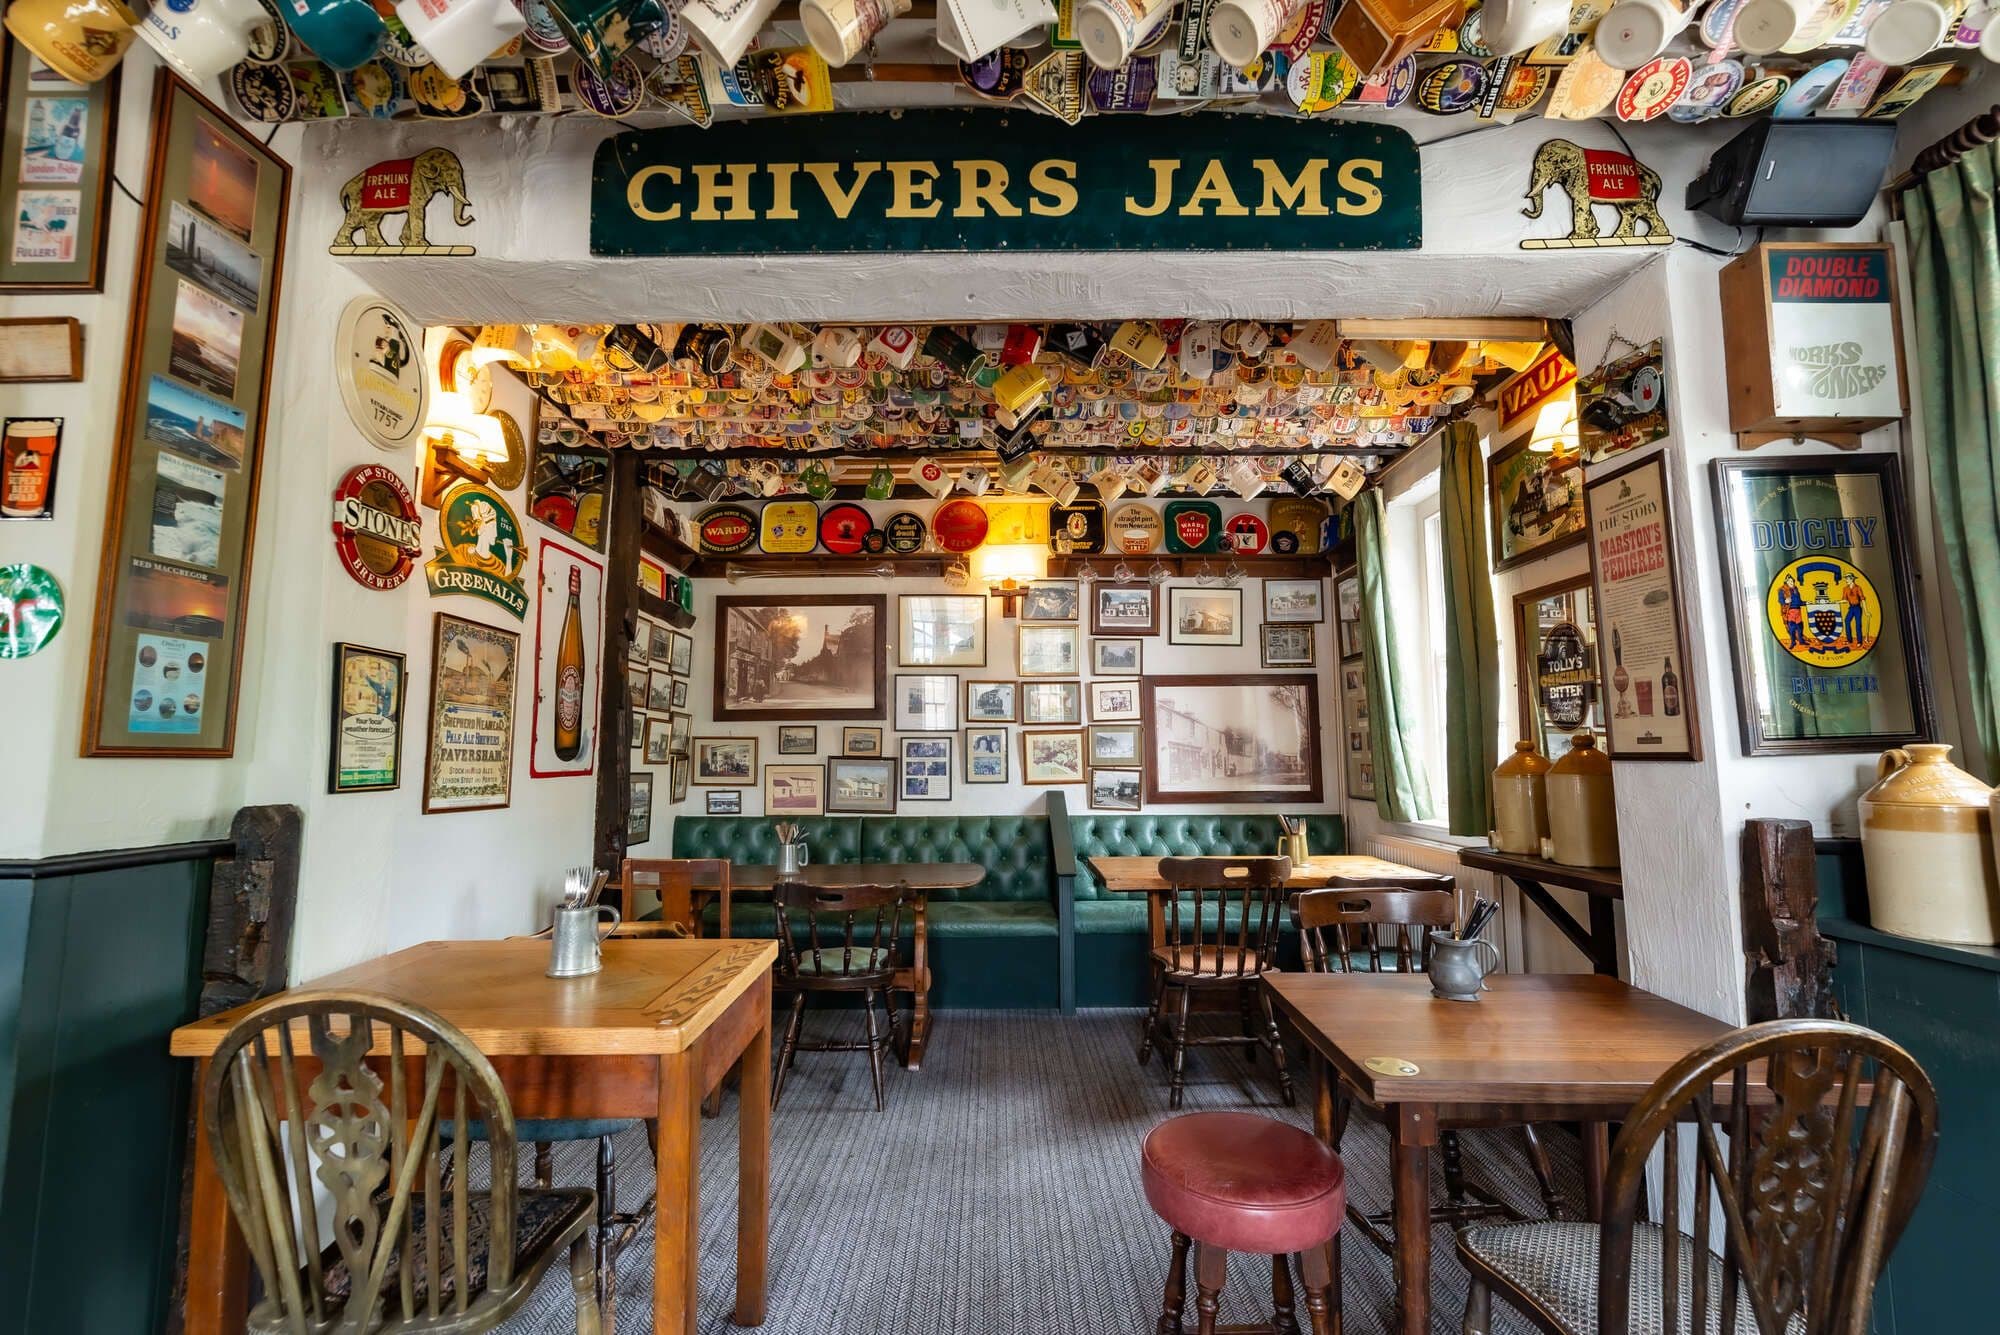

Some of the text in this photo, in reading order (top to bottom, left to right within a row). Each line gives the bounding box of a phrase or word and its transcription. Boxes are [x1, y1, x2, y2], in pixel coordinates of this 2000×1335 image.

[1184, 17, 1200, 58] SHARPIE
[1425, 65, 1457, 112] GRAVITY
[1648, 64, 1690, 116] TITANIC
[1481, 87, 1500, 118] BITTER
[367, 174, 409, 187] FREMLINS
[1590, 163, 1636, 177] FREMLINS
[374, 188, 396, 199] ALE
[627, 159, 1383, 221] CHIVERS JAMS
[1602, 178, 1625, 190] ALE
[1786, 257, 1872, 277] DOUBLE
[1778, 278, 1880, 298] DIAMOND
[1503, 356, 1576, 415] VAUX
[373, 407, 399, 430] 1757
[375, 468, 412, 504] STONES
[345, 497, 421, 548] STONES
[1118, 515, 1153, 524] straight pint
[1599, 514, 1619, 533] THE
[1622, 501, 1658, 522] STORY
[706, 525, 749, 537] WARDS
[1600, 522, 1662, 560] MARSTON'S
[1751, 516, 1878, 551] DUCHY
[133, 558, 209, 581] RED MACGREGOR
[353, 558, 406, 589] BREWERY
[1602, 543, 1665, 583] PEDIGREE
[434, 568, 525, 611] GREENALLS
[1548, 654, 1583, 673] TOLLY'S
[1549, 684, 1585, 699] BITTER
[1791, 674, 1880, 695] BITTER
[440, 747, 503, 762] FAVERSHAM
